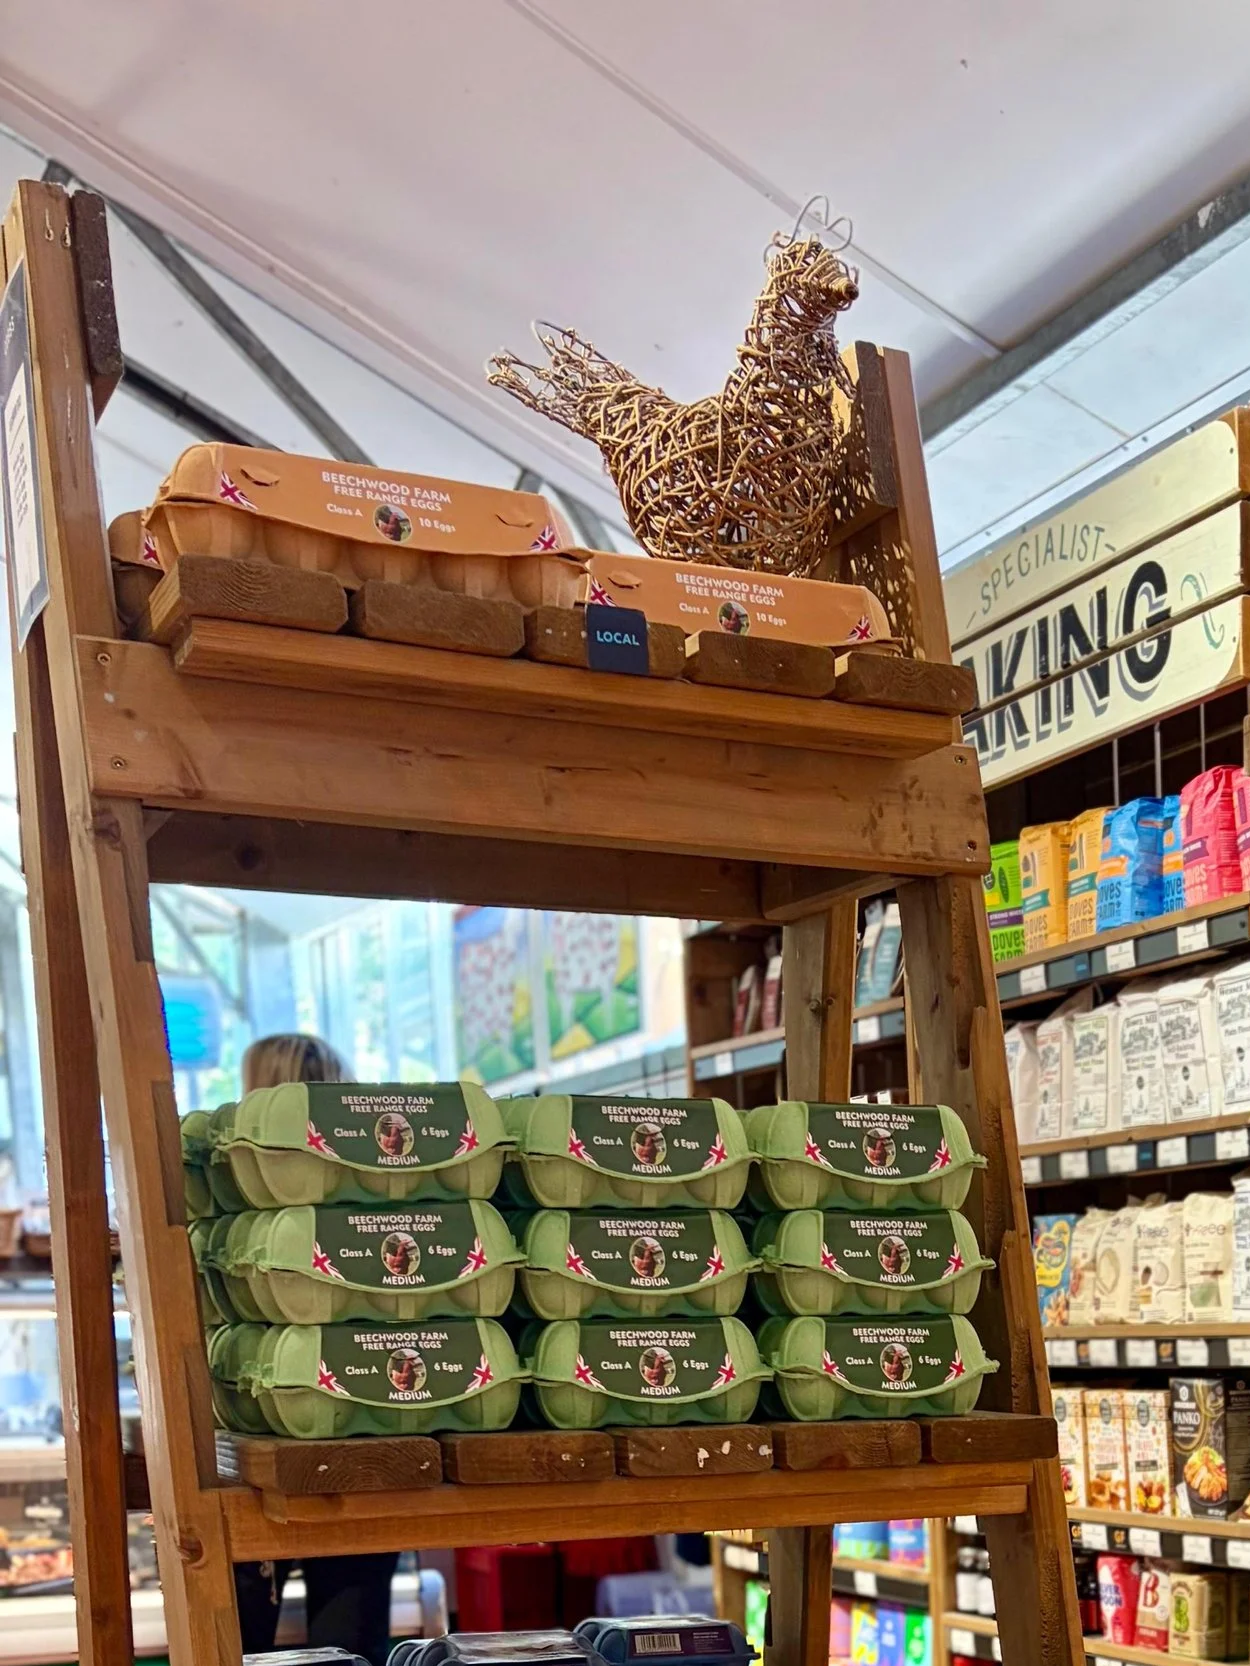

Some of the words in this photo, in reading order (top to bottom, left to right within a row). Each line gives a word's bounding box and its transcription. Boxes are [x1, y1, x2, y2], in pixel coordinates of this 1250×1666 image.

[322, 471, 410, 495] BEECHWOOD
[414, 487, 452, 504] FARM
[334, 485, 362, 498] FREE
[366, 490, 407, 506] RANGE
[411, 499, 442, 512] EGGS
[327, 503, 352, 516] Class
[355, 508, 363, 517] A
[419, 517, 432, 528] 10
[433, 520, 456, 533] Eggs
[980, 523, 1105, 615] SPECIALIST
[675, 573, 749, 592] BEECHWOOD
[752, 584, 784, 598] FARM
[597, 631, 640, 647] LOCAL
[961, 561, 1173, 766] AKING
[341, 1095, 405, 1105] BEECHWOOD
[407, 1096, 434, 1105] FARM
[350, 1105, 372, 1113] FREE
[374, 1105, 403, 1113] RANGE
[405, 1105, 428, 1114] EGGS
[334, 1128, 358, 1137] Class
[359, 1128, 367, 1137] A
[421, 1127, 427, 1136] 6
[431, 1127, 449, 1138] Eggs
[377, 1155, 420, 1166] MEDIUM
